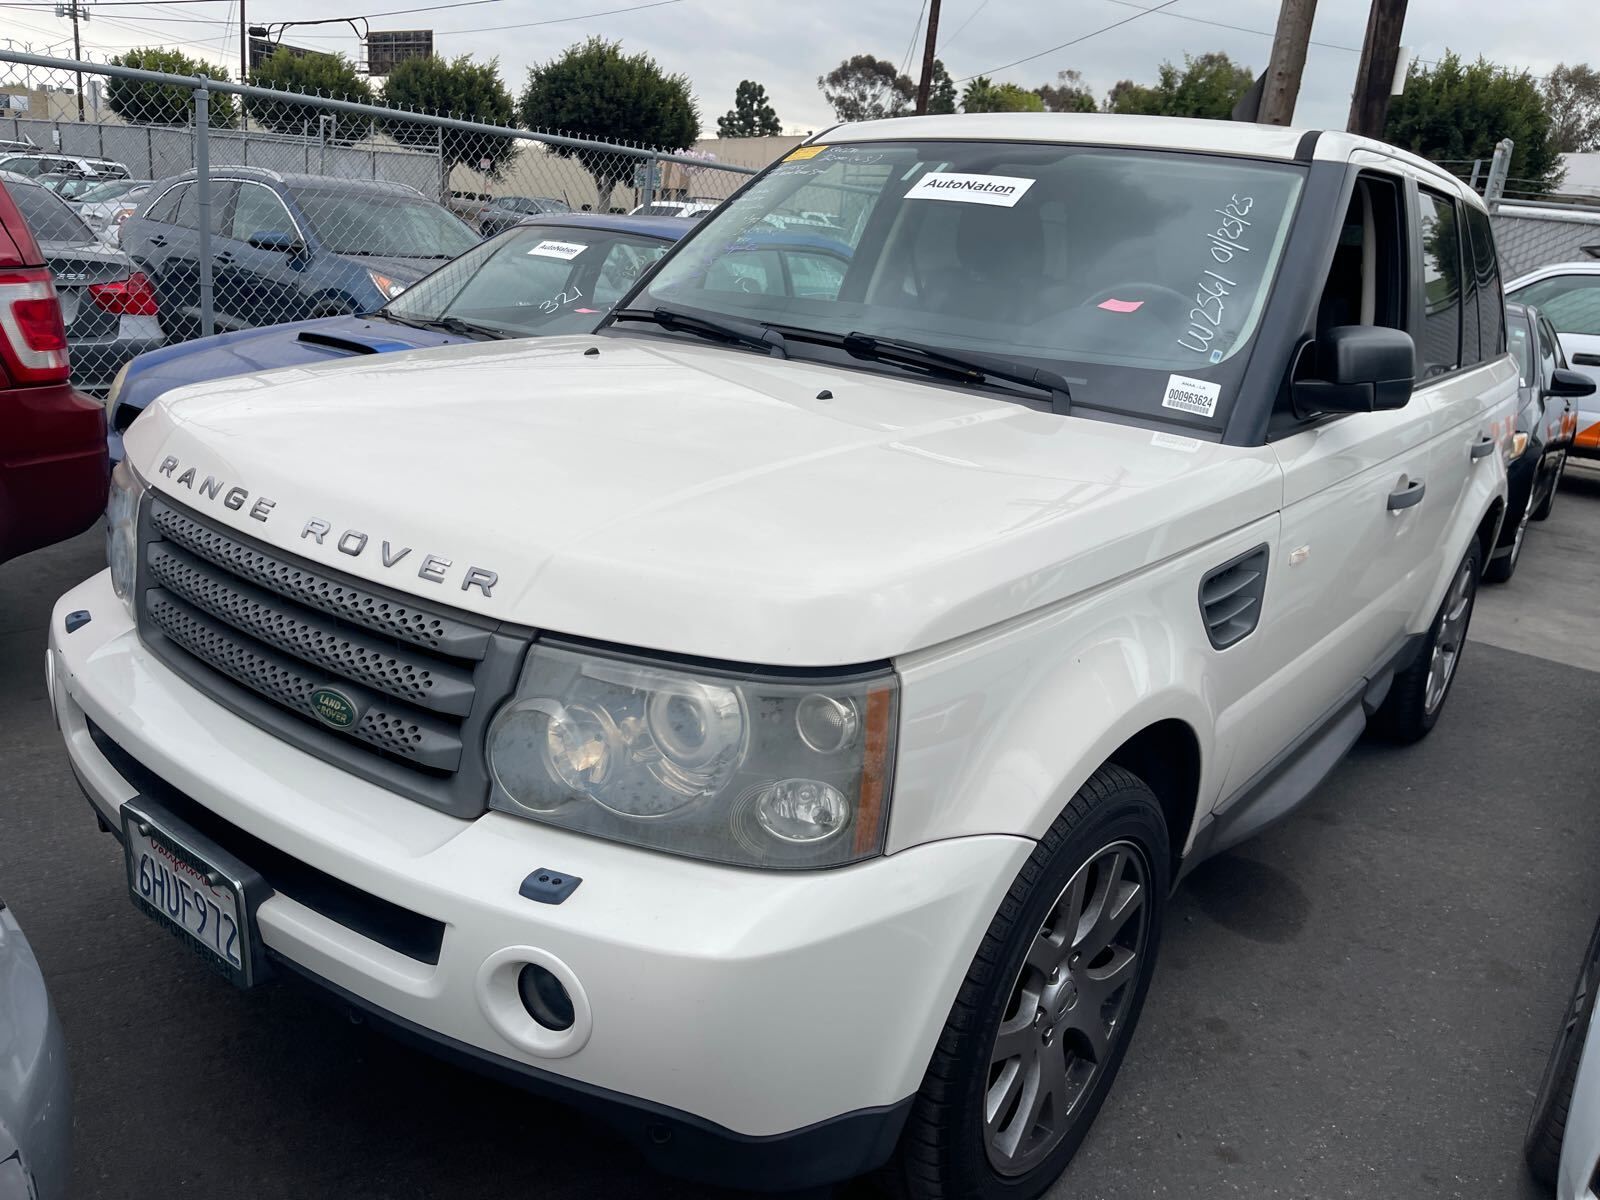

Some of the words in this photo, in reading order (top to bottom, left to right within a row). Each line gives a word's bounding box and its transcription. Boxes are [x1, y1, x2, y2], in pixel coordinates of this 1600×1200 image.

[923, 178, 1016, 195] AutoNation
[539, 243, 578, 255] AutoNation
[538, 285, 583, 314] 321
[1168, 388, 1213, 409] 000963624
[158, 454, 277, 523] RANGE
[300, 516, 499, 598] ROVER
[319, 693, 342, 711] LAND
[320, 704, 348, 724] ROVER
[139, 852, 241, 967] 6HUF972
